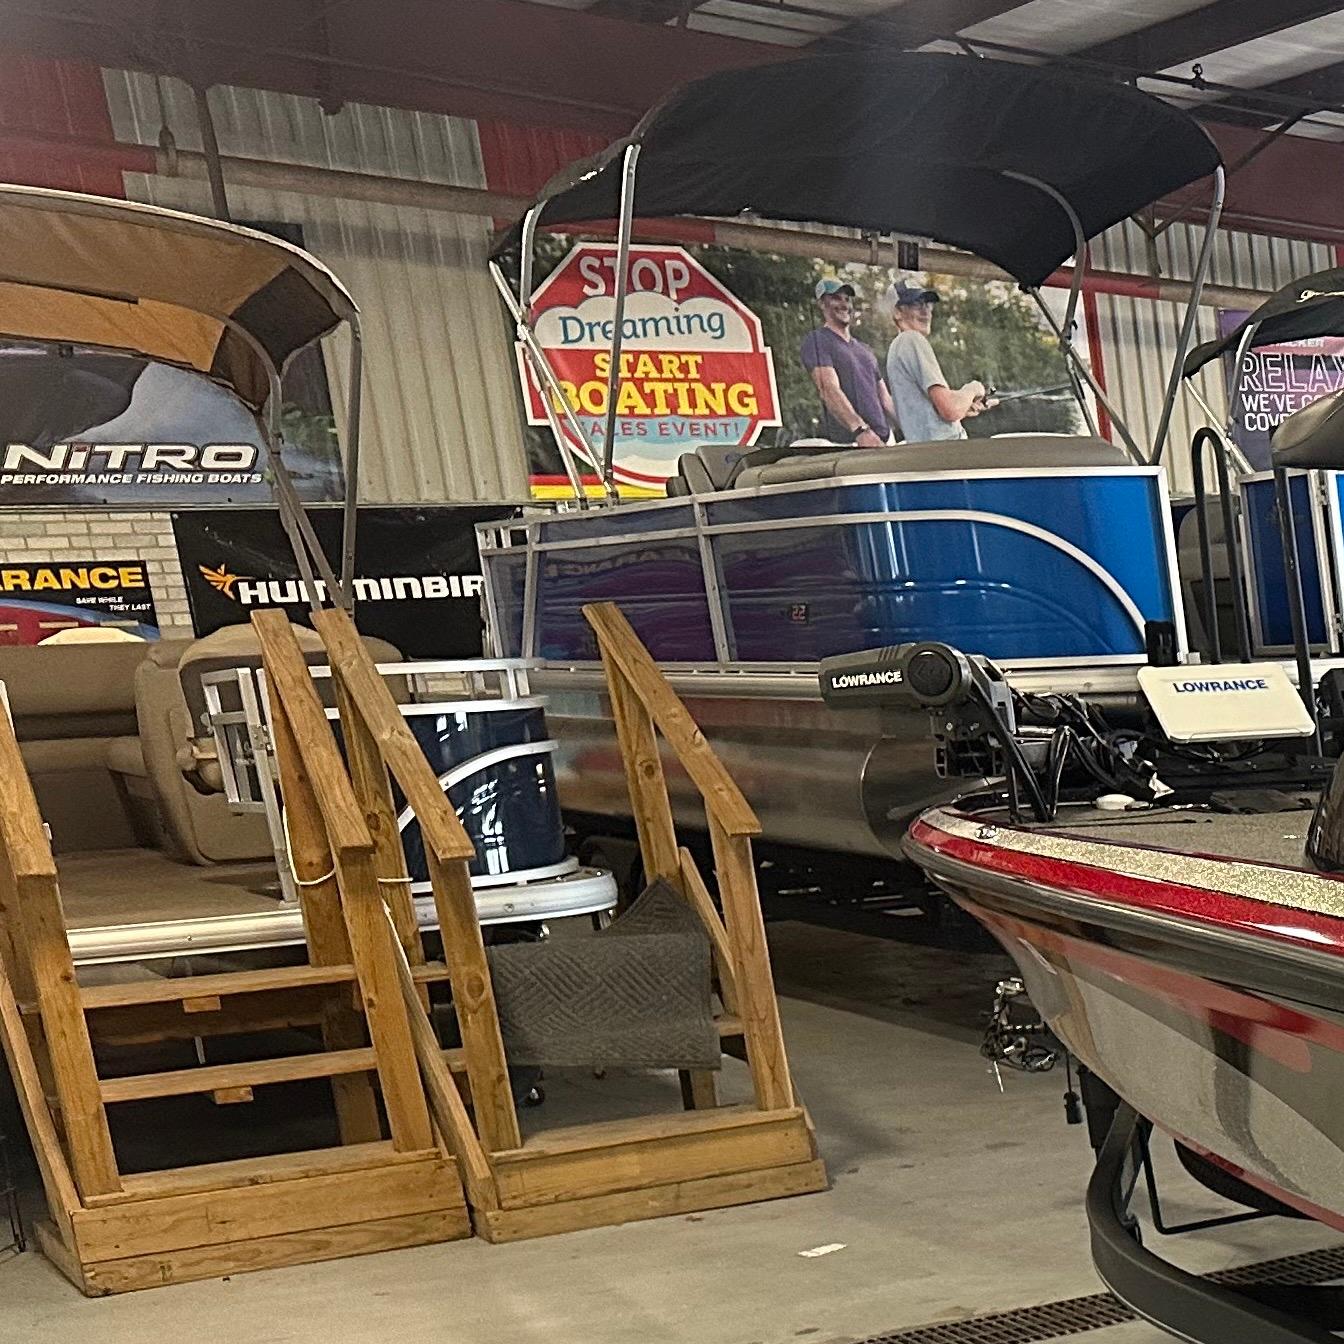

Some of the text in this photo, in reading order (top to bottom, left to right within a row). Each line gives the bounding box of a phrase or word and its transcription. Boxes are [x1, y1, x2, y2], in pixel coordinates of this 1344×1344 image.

[580, 255, 691, 300] STOP
[559, 306, 726, 345] Dreaming
[593, 352, 704, 379] START
[552, 381, 760, 416] BOATING
[1241, 394, 1299, 413] WE'VE
[659, 421, 740, 437] EVENT!
[3, 443, 258, 470] NITRO
[0, 472, 263, 485] PERFORMANCE FISHING BOATS
[109, 602, 151, 611] THEY LAST
[832, 670, 902, 689] LOWRANCE
[1173, 678, 1269, 693] LOWRANCE
